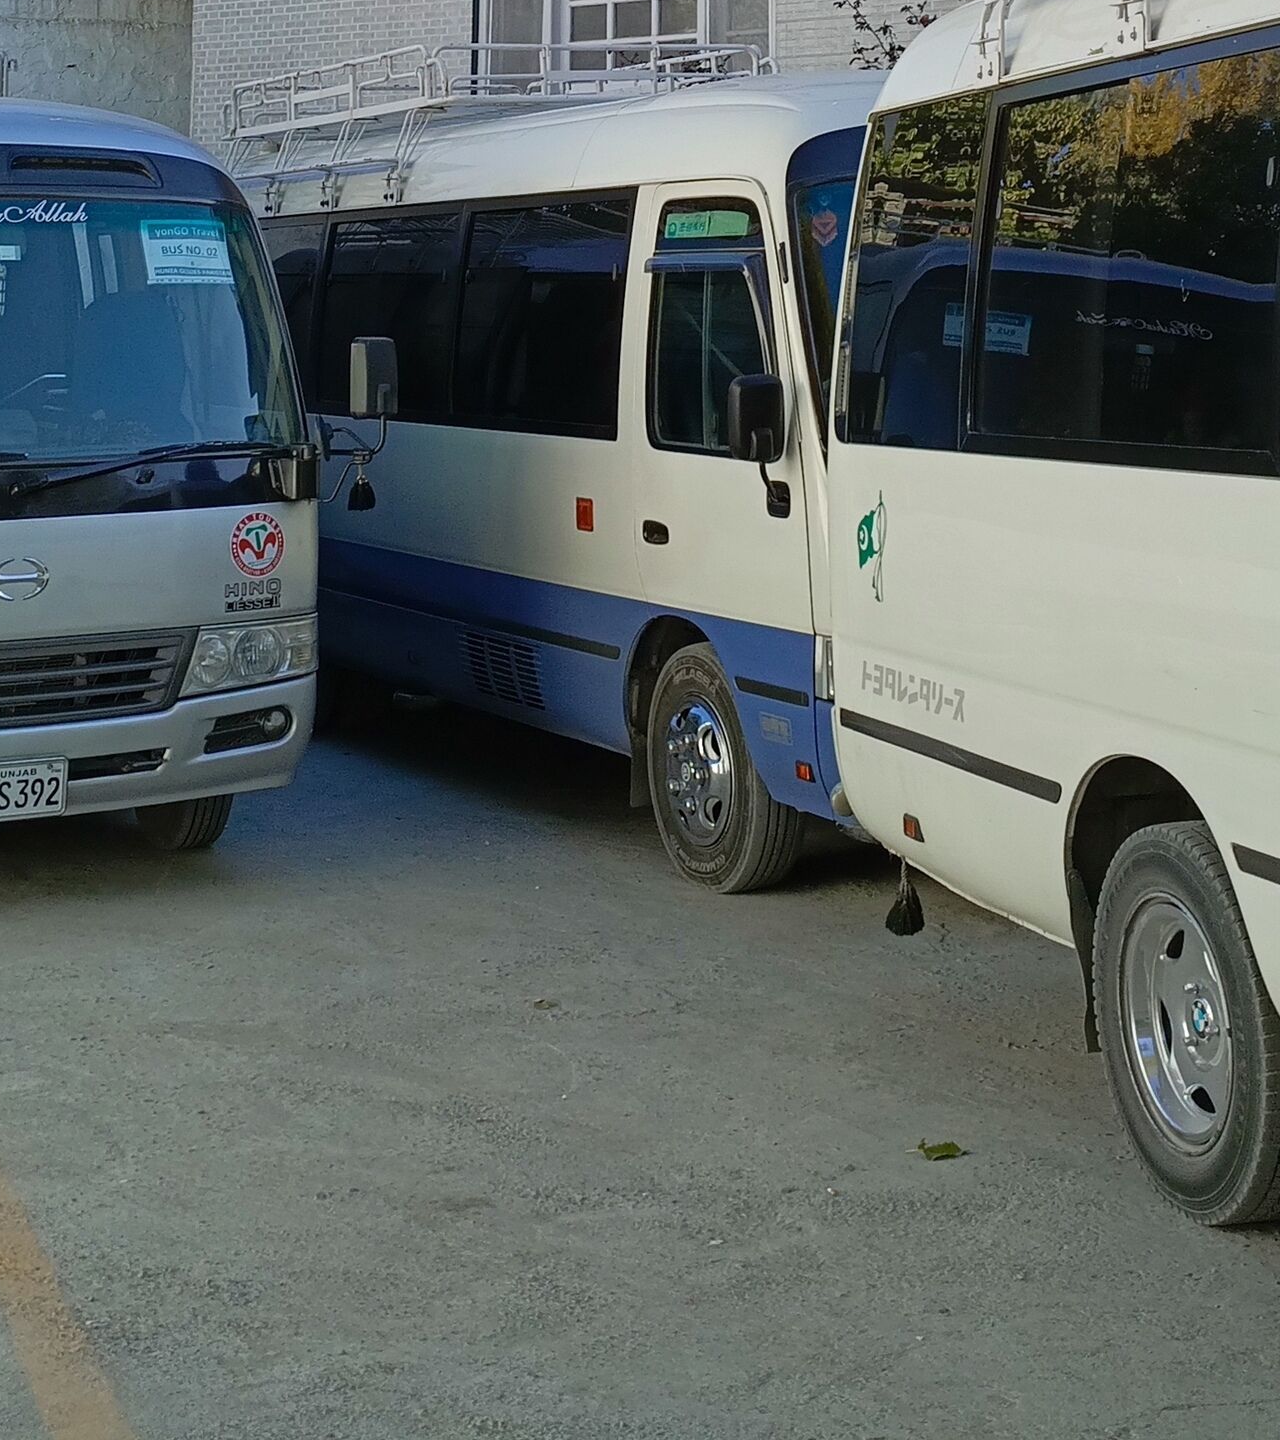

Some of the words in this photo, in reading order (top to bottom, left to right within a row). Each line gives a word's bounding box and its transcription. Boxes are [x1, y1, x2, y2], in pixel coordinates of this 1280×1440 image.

[4, 199, 88, 223] Allah
[154, 227, 189, 238] yonGO
[191, 226, 219, 237] Travel
[161, 244, 184, 255] BUS
[186, 245, 204, 256] NO.
[206, 247, 218, 257] 02
[224, 577, 281, 598] HINO
[861, 660, 966, 723] トヨタレンタリース
